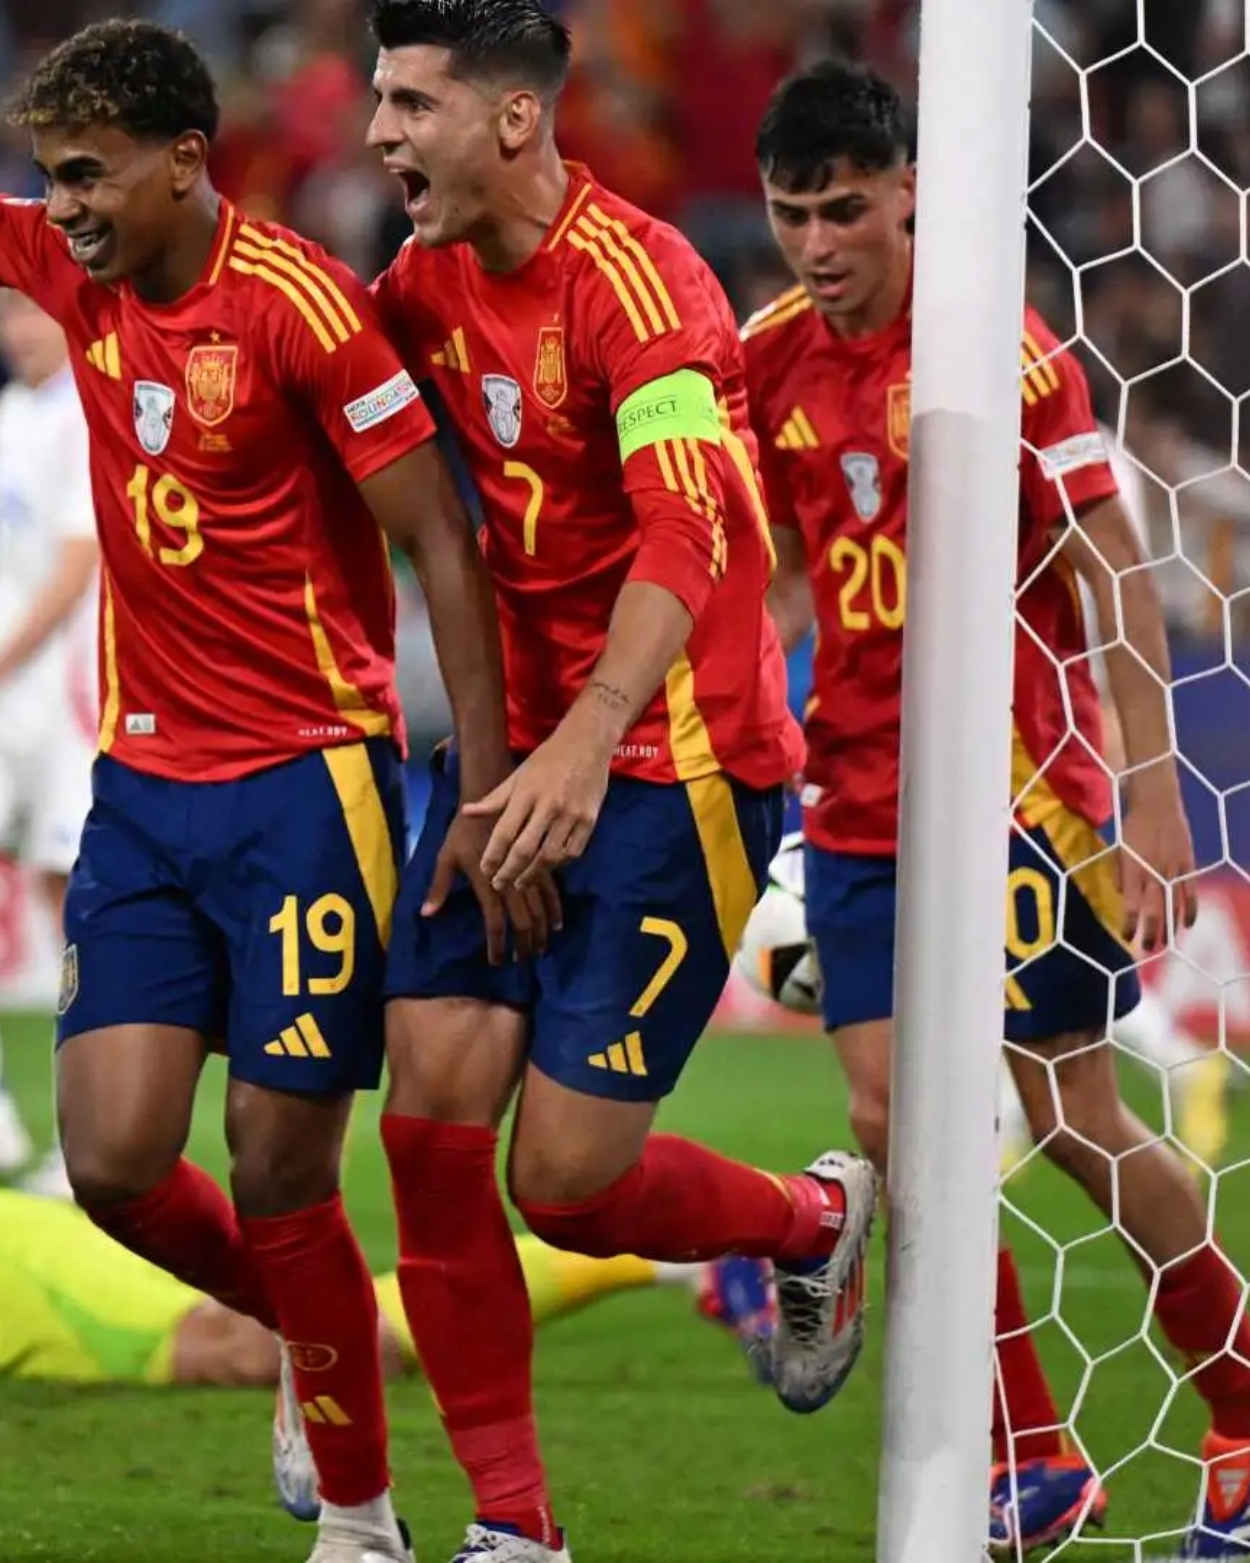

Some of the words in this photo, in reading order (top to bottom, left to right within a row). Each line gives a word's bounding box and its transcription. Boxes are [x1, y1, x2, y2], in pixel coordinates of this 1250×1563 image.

[127, 464, 204, 566] 19
[504, 461, 543, 556] 7
[830, 535, 906, 630] 20
[269, 892, 355, 996] 19
[629, 916, 689, 1018] 7
